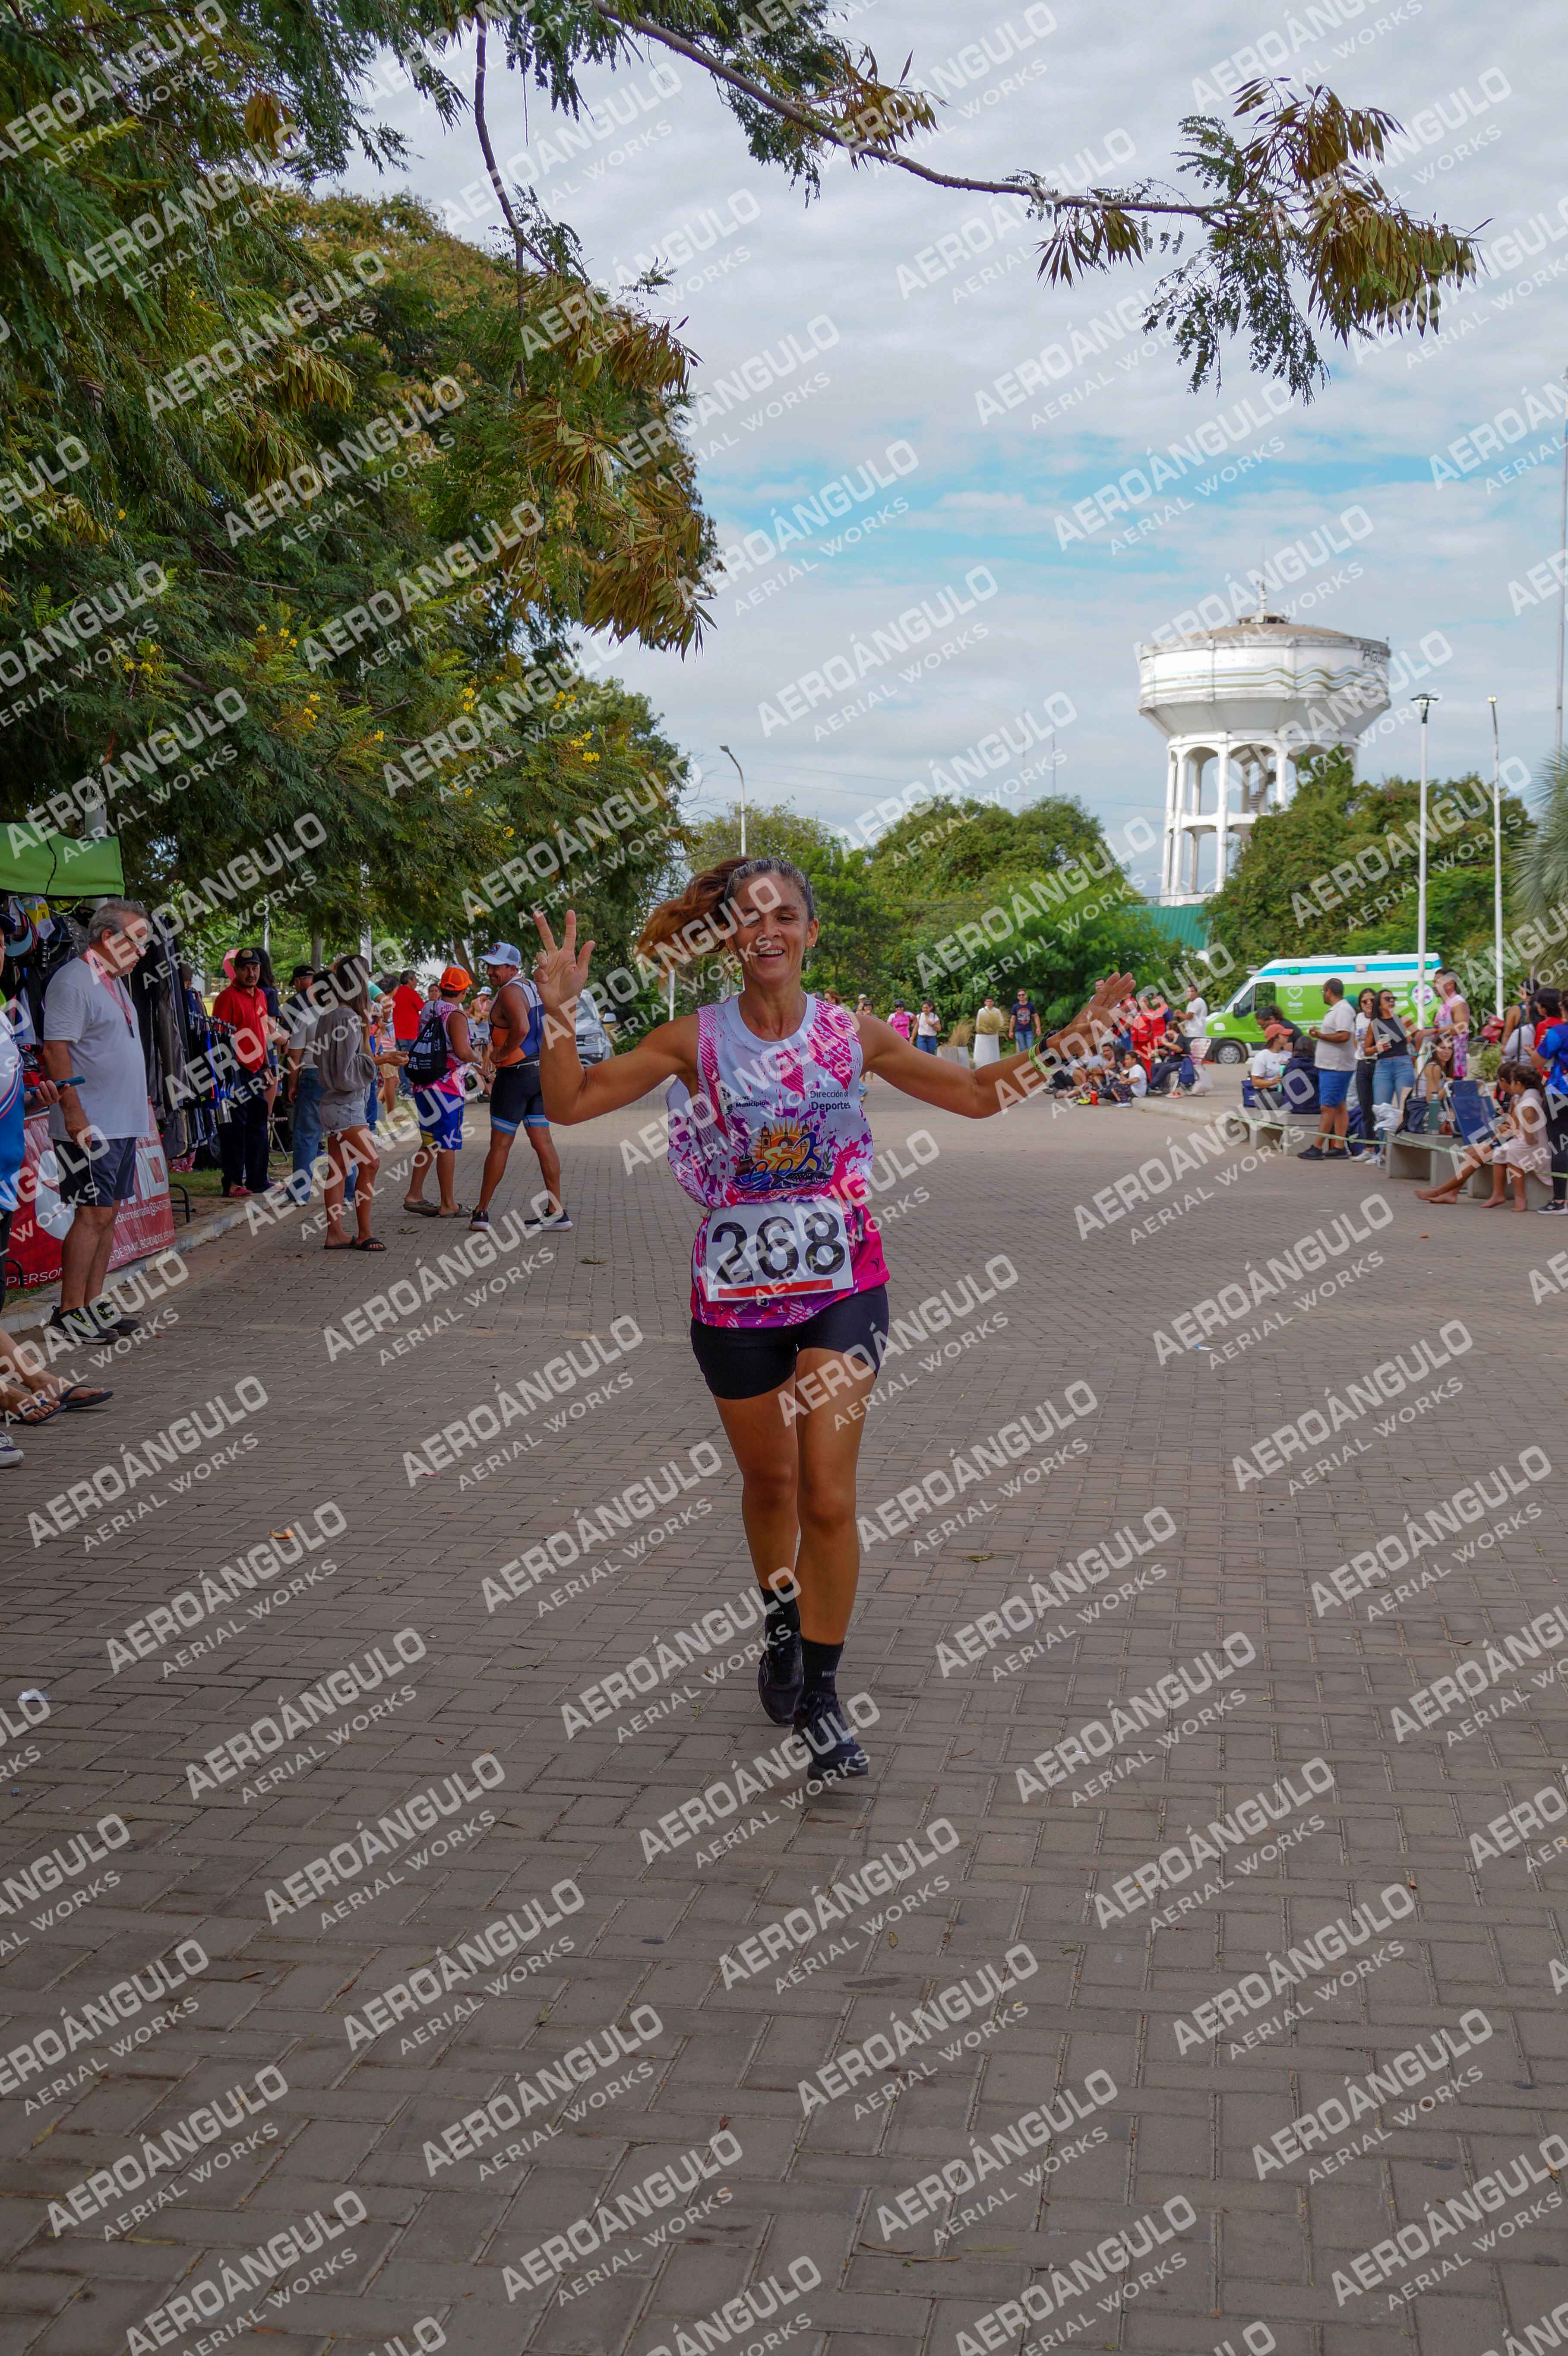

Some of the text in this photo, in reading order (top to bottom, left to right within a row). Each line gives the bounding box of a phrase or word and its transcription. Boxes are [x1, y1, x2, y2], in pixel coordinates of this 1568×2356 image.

[810, 1090, 843, 1098] Dirección
[811, 1101, 851, 1112] Deportes
[711, 1212, 845, 1285] 268
